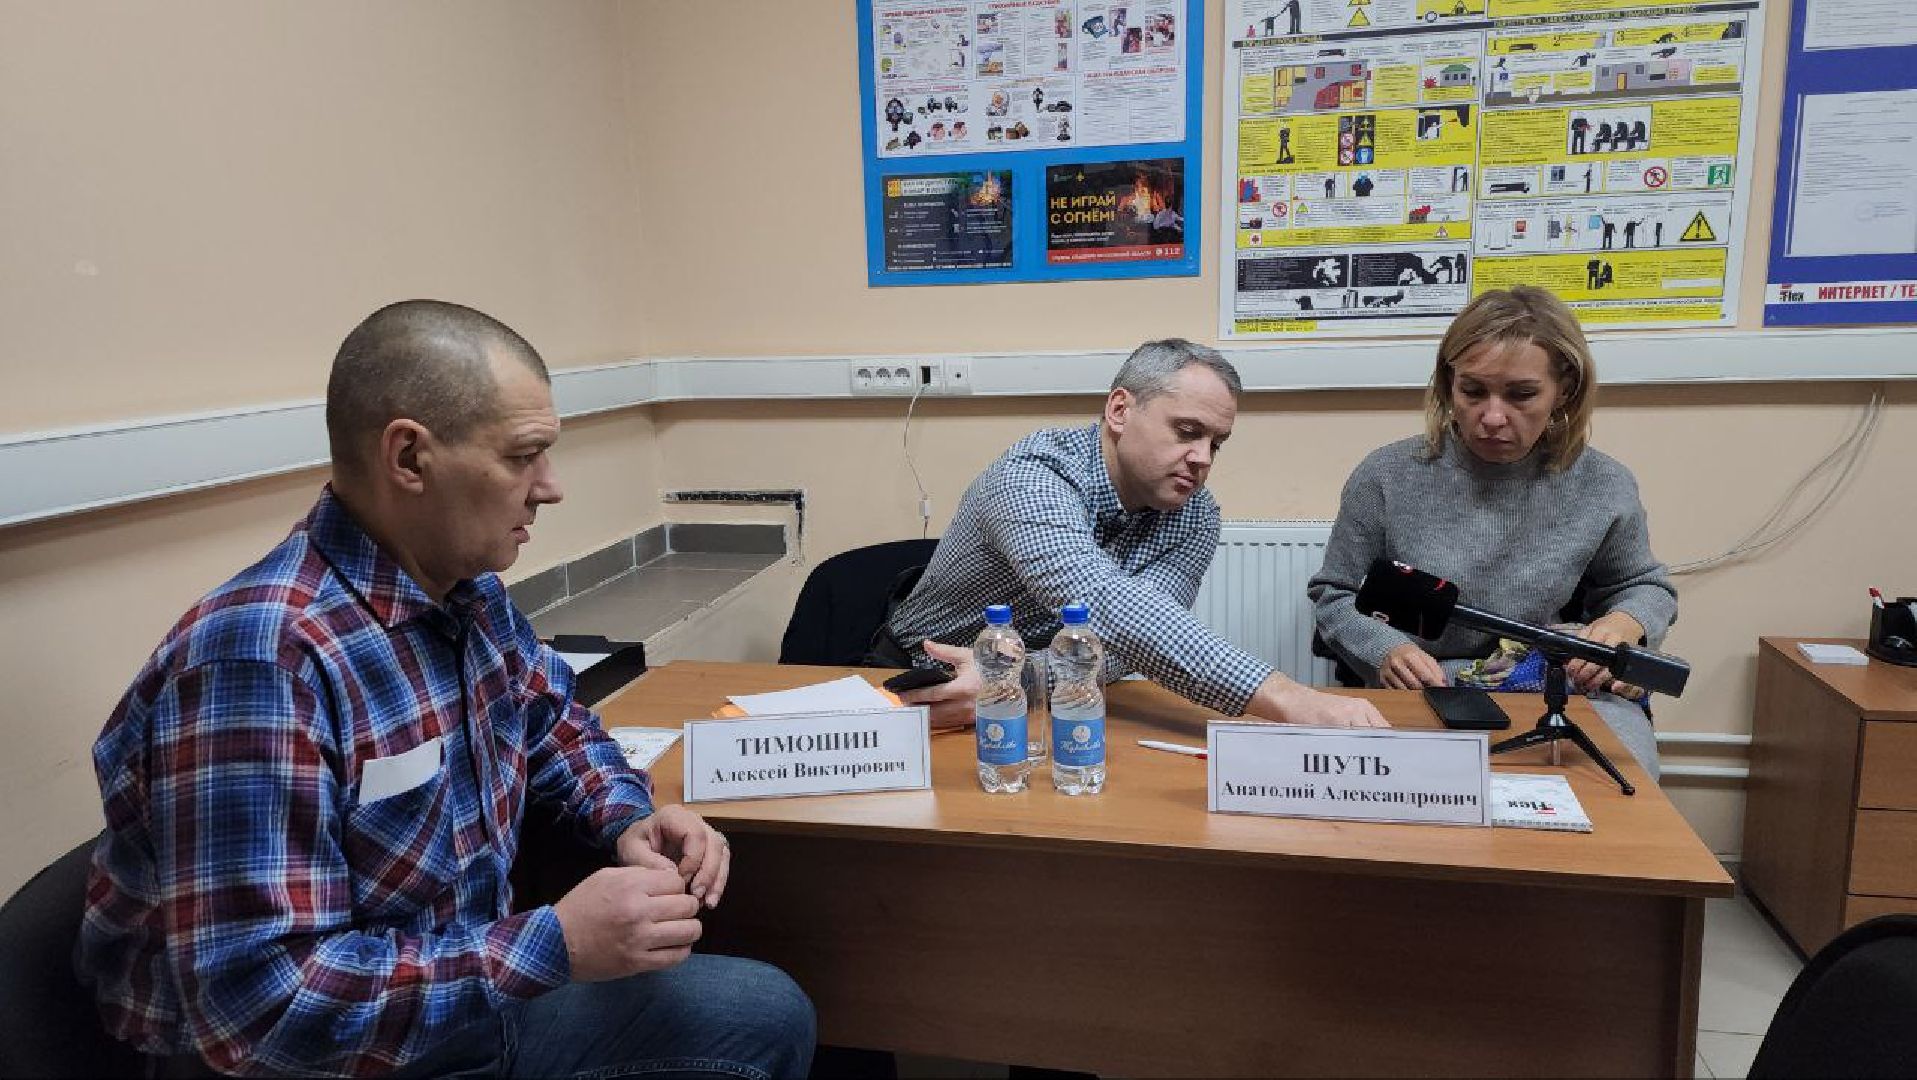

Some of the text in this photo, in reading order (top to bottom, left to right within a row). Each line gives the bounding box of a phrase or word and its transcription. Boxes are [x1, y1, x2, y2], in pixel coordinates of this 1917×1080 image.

[1051, 191, 1116, 209] НЕ ИГРАЙ
[1051, 208, 1115, 224] С ОГНЁМ!
[1165, 247, 1181, 255] 112
[1818, 285, 1888, 300] ИНТЕРНЕТ
[736, 730, 879, 756] ТИМОШИН
[711, 760, 906, 783] Алексей Викторович
[1303, 753, 1391, 776] ШУТЬ
[1221, 781, 1478, 808] Анатолий Александрович
